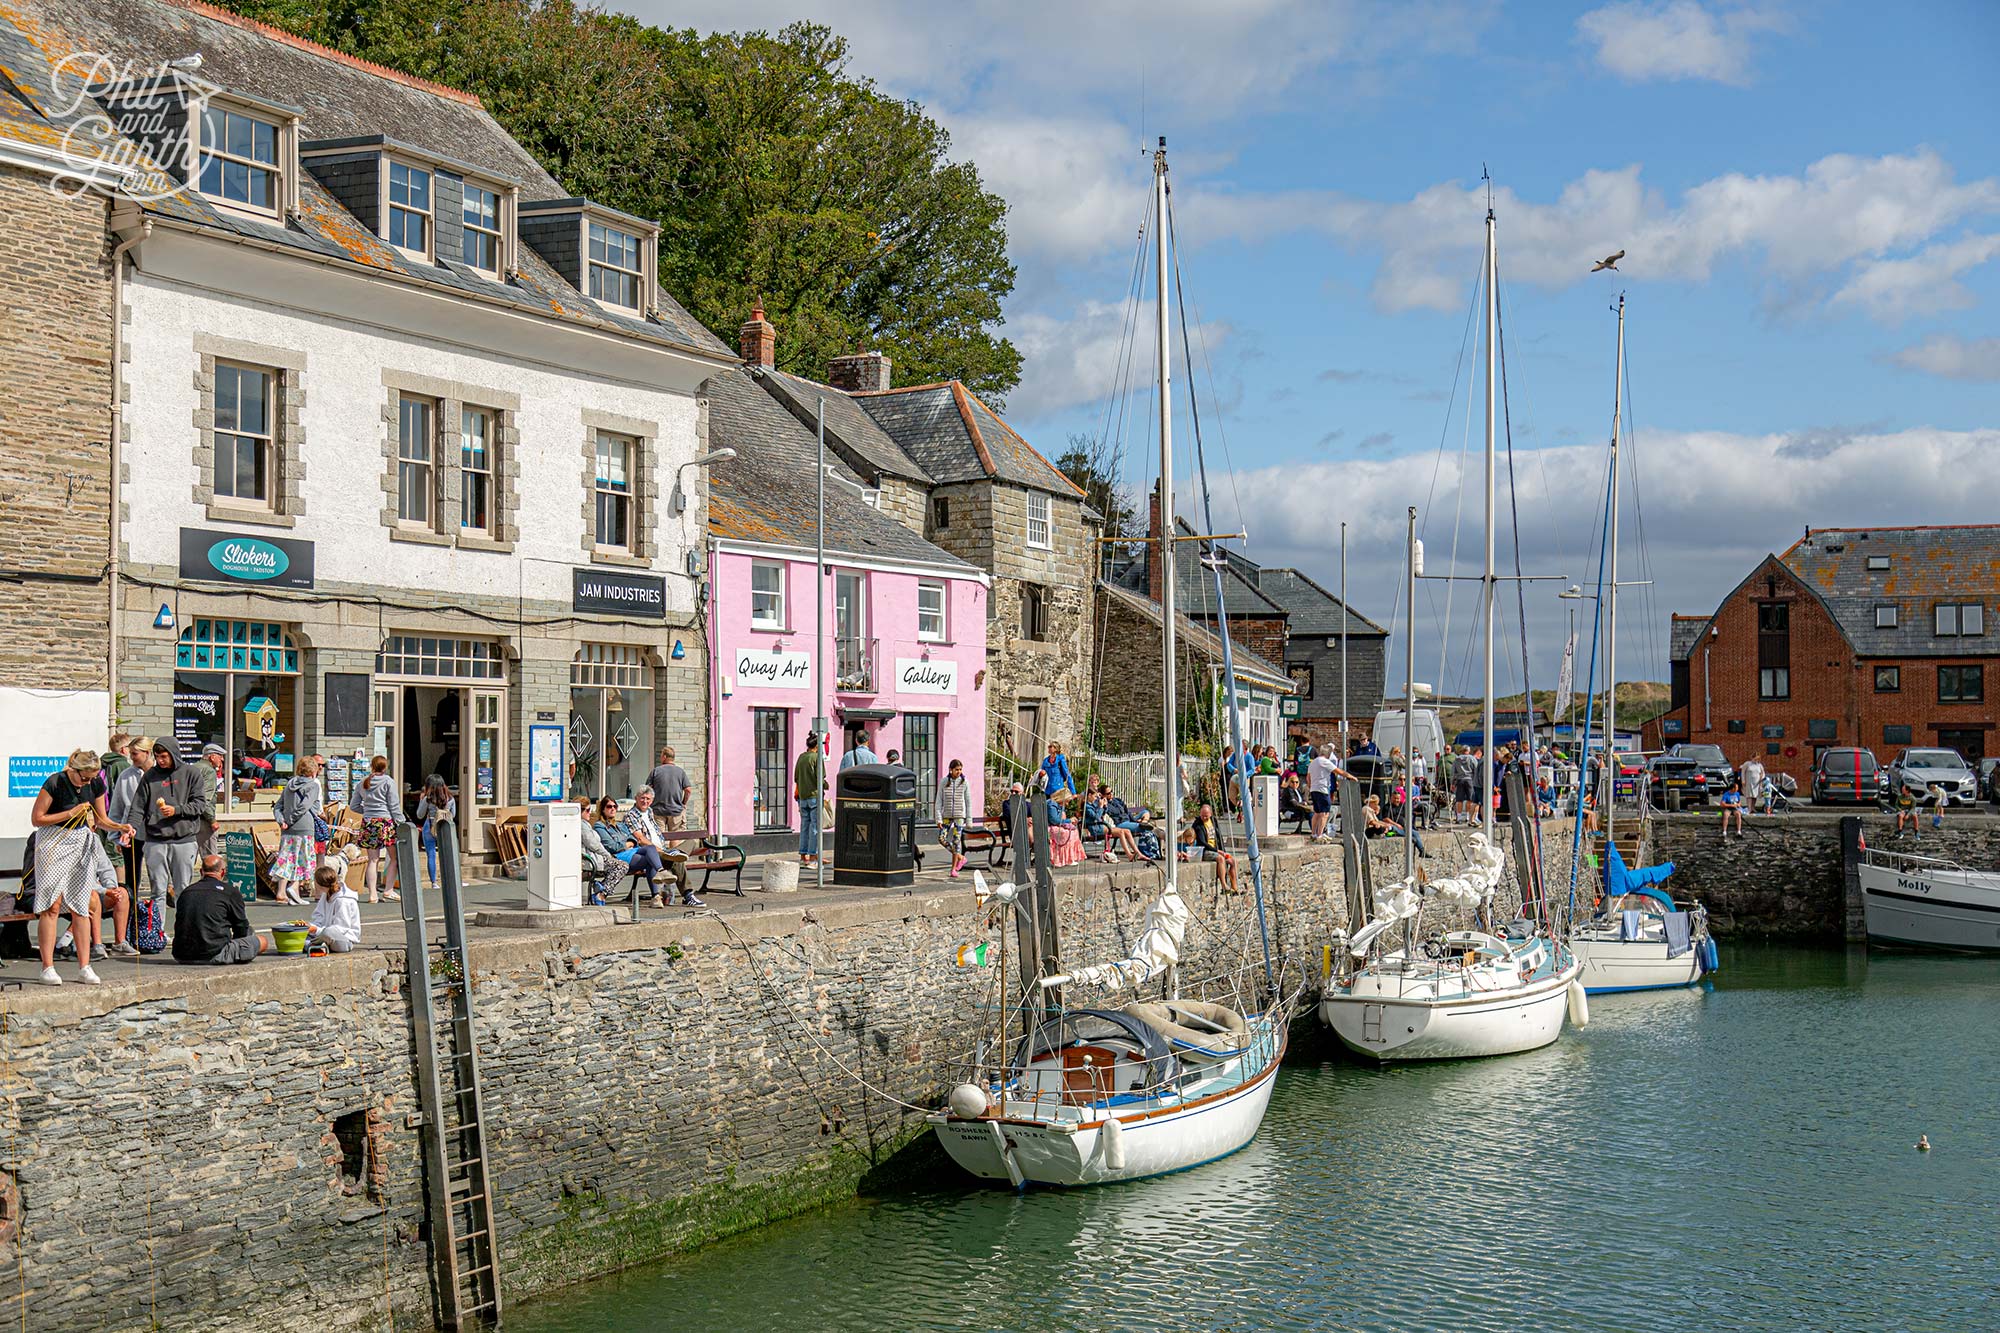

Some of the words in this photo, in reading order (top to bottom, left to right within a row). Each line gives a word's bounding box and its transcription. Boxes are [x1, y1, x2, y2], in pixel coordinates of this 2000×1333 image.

[222, 544, 276, 567] Slickers
[580, 583, 602, 598] JAM
[604, 585, 661, 604] INDUSTRIES
[738, 657, 778, 681] Quay
[781, 659, 809, 679] Art
[903, 666, 951, 690] Gallery
[10, 759, 47, 767] HARBOUR
[1897, 878, 1931, 894] Molly
